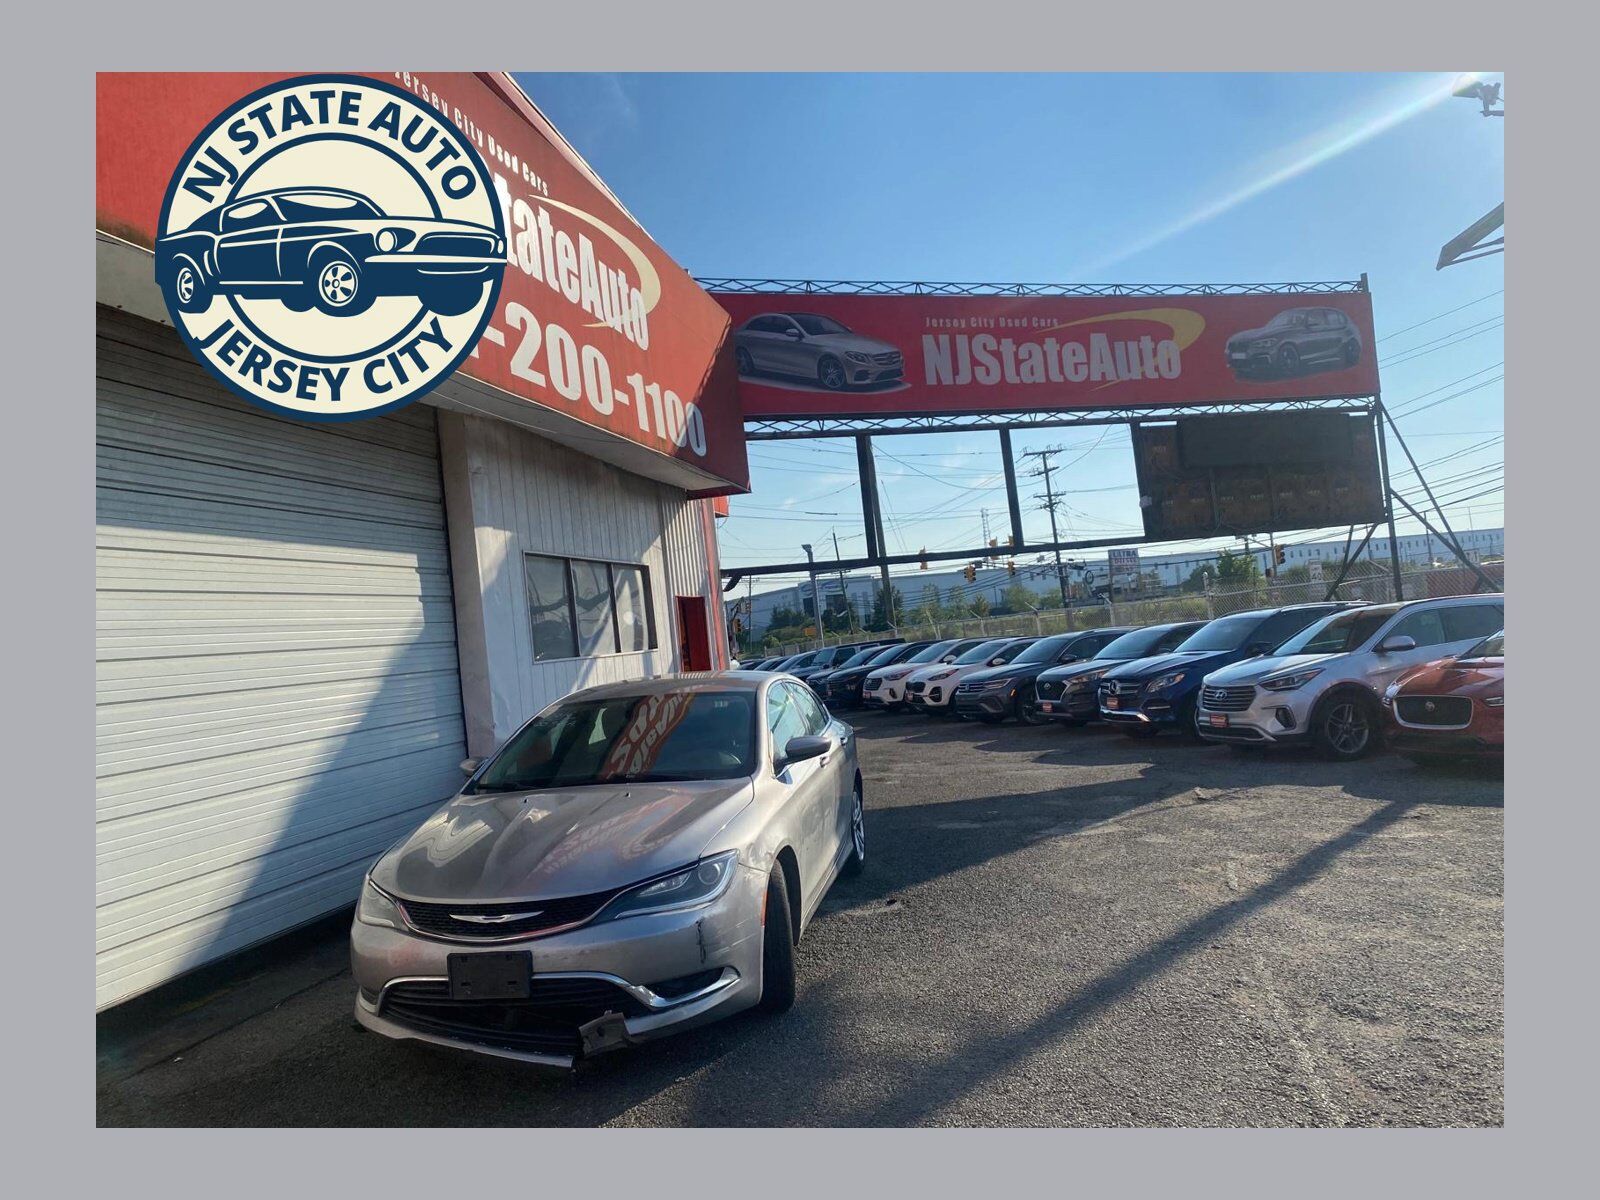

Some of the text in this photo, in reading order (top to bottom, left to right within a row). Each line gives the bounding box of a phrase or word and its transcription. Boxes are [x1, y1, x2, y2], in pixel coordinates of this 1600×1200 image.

[454, 107, 483, 148] City
[487, 134, 519, 174] Used
[522, 162, 548, 196] Cars
[492, 171, 649, 351] tateAuto
[922, 333, 1182, 386] NJStateAuto
[926, 316, 1059, 329] Jersey City Used Cars
[471, 301, 707, 457] -200-1100
